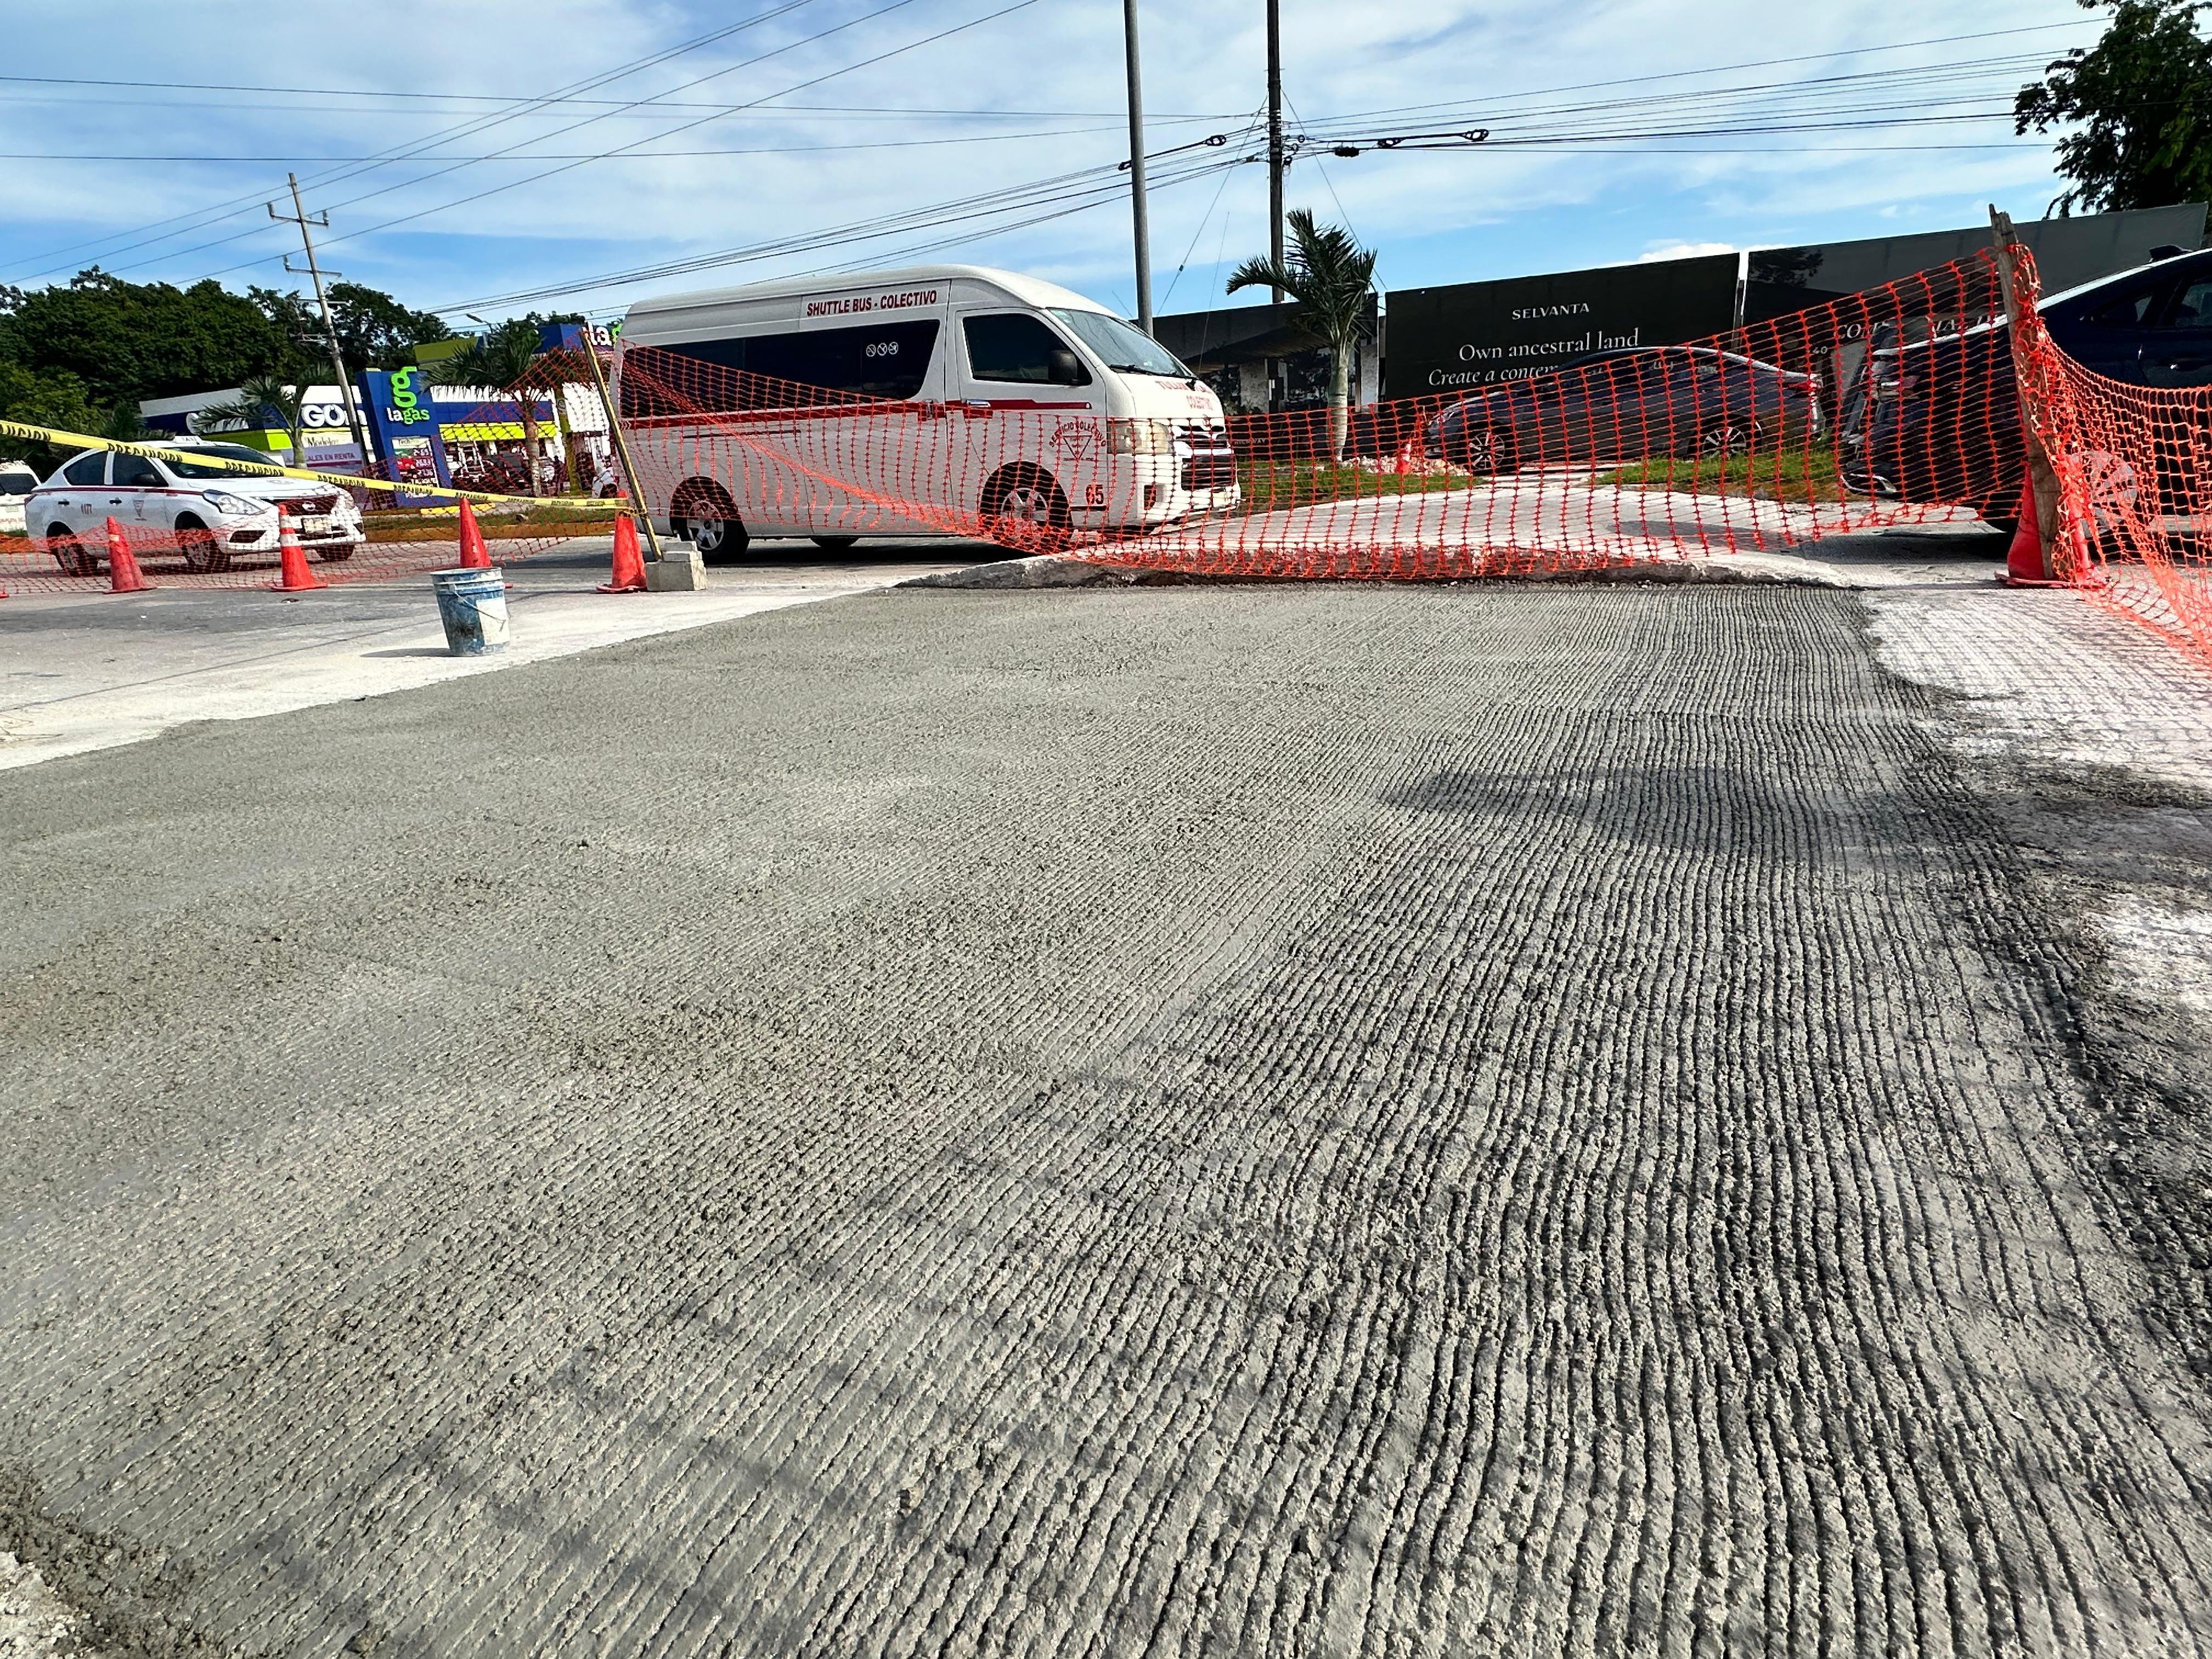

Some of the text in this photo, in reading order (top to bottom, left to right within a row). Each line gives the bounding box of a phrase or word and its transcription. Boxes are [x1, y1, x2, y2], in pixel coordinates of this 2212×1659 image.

[806, 300, 850, 317] SHUTTLE
[853, 297, 872, 312] BUS
[880, 290, 937, 309] COLECTIVO
[1512, 303, 1590, 320] SELVANTA
[1459, 328, 1639, 361] Own ancestral land
[1429, 369, 1480, 386] Create
[1485, 370, 1496, 382] a
[387, 408, 430, 425] lagas
[1086, 484, 1104, 504] 65
